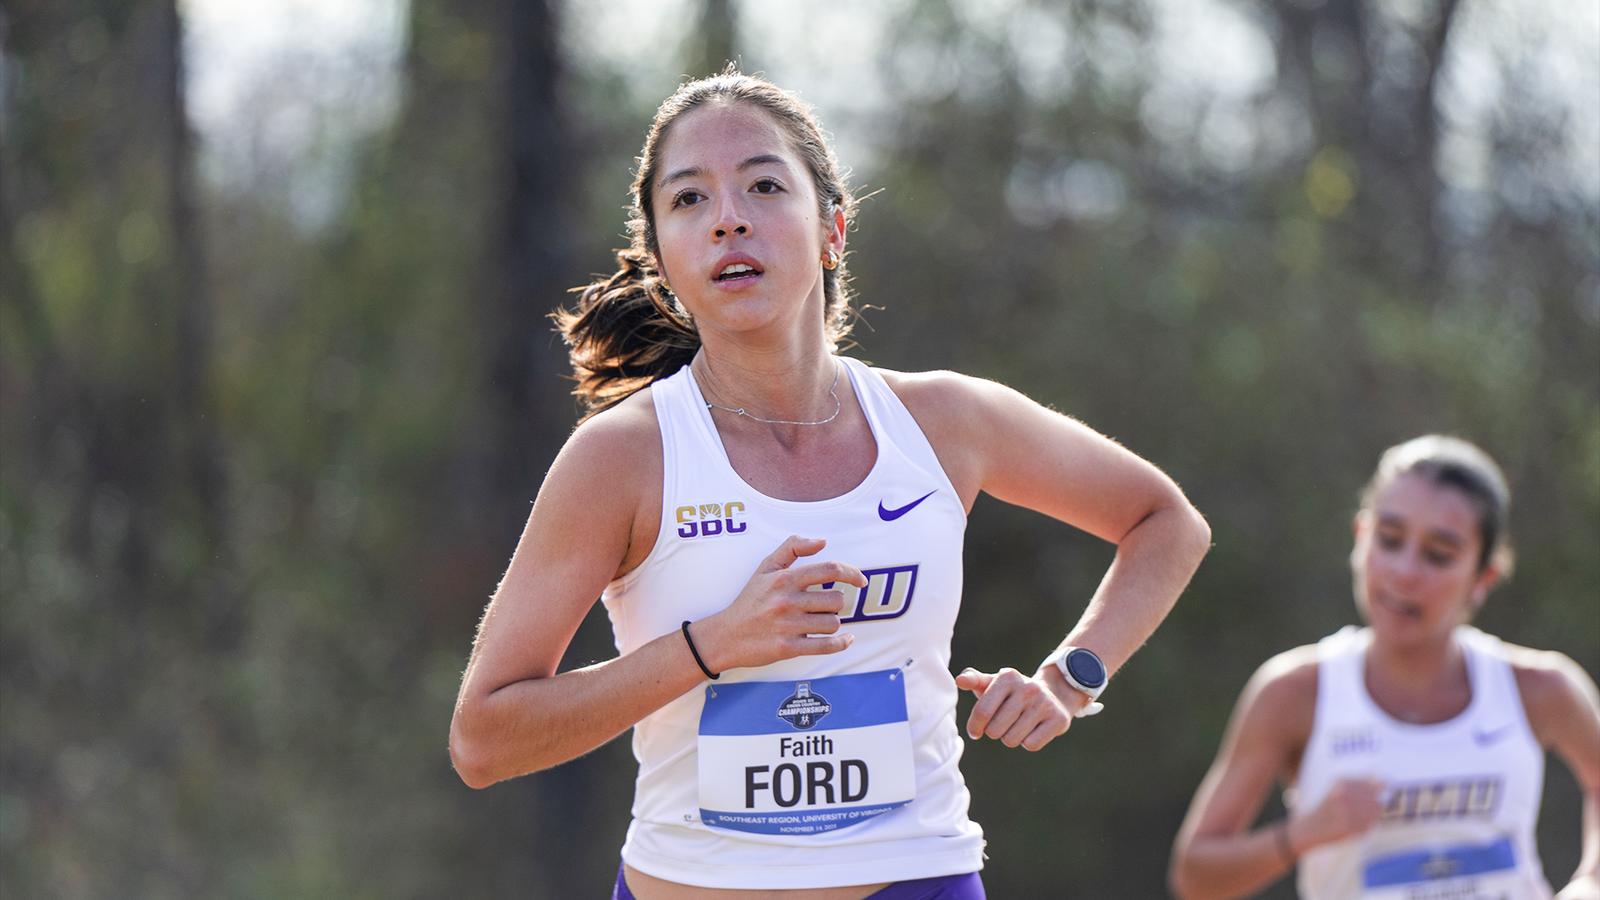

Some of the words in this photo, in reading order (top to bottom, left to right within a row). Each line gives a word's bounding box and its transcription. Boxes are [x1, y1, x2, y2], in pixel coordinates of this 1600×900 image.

[676, 501, 747, 539] SBC
[778, 704, 830, 716] CHAMPIONSHIPS
[780, 735, 833, 757] Faith
[745, 759, 869, 808] FORD
[719, 815, 766, 824] SOUTHEAST
[768, 816, 801, 824] REGION,
[803, 812, 848, 822] UNIVERSITY
